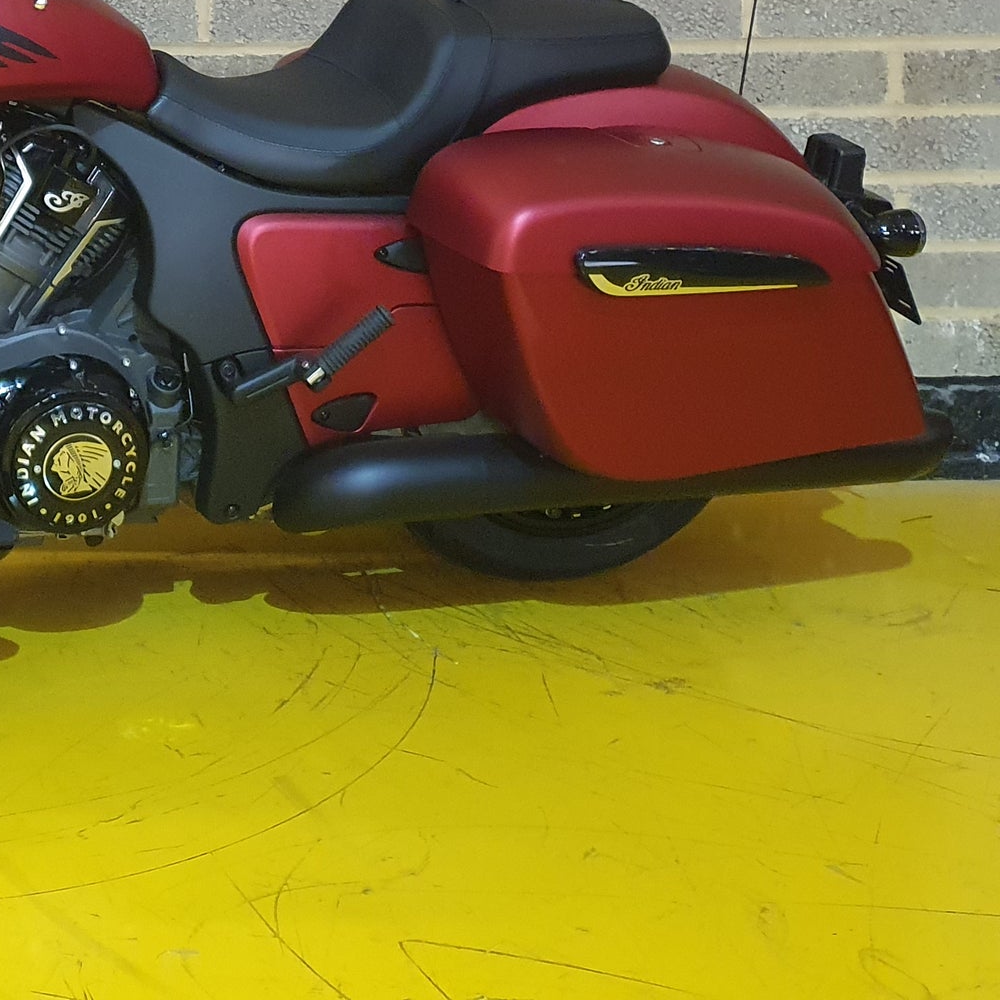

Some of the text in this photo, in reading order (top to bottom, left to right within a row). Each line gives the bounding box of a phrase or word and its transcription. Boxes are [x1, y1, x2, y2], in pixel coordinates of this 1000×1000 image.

[624, 273, 682, 292] Indian
[16, 405, 137, 506] INDIAN MOTORCYCLE
